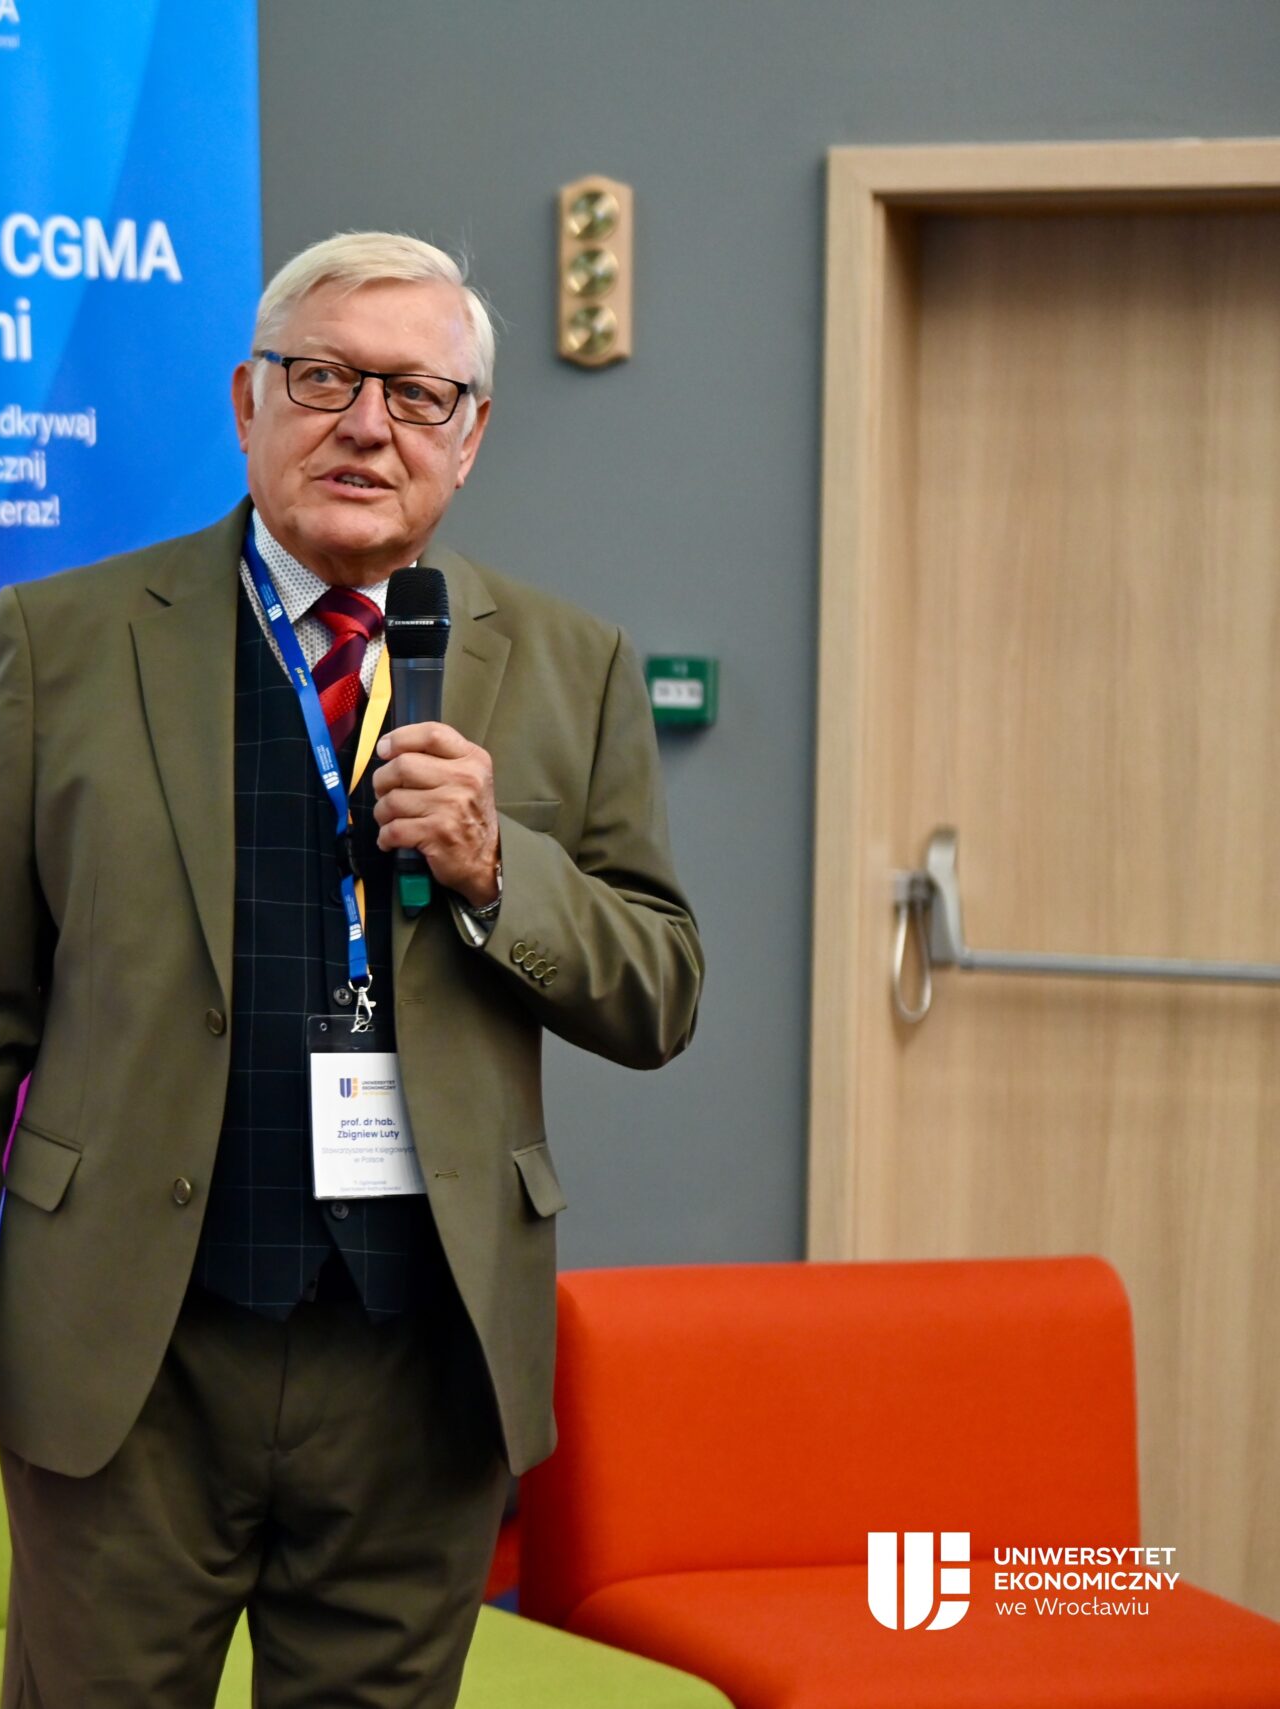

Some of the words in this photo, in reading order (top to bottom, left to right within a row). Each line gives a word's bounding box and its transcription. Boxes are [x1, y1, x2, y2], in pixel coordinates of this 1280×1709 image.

[0, 212, 183, 283] CGMA
[341, 1118, 361, 1128] prof.
[363, 1118, 373, 1126] dr
[375, 1118, 396, 1126] hab.
[337, 1131, 378, 1140] Zbigniew
[380, 1131, 400, 1140] Luty
